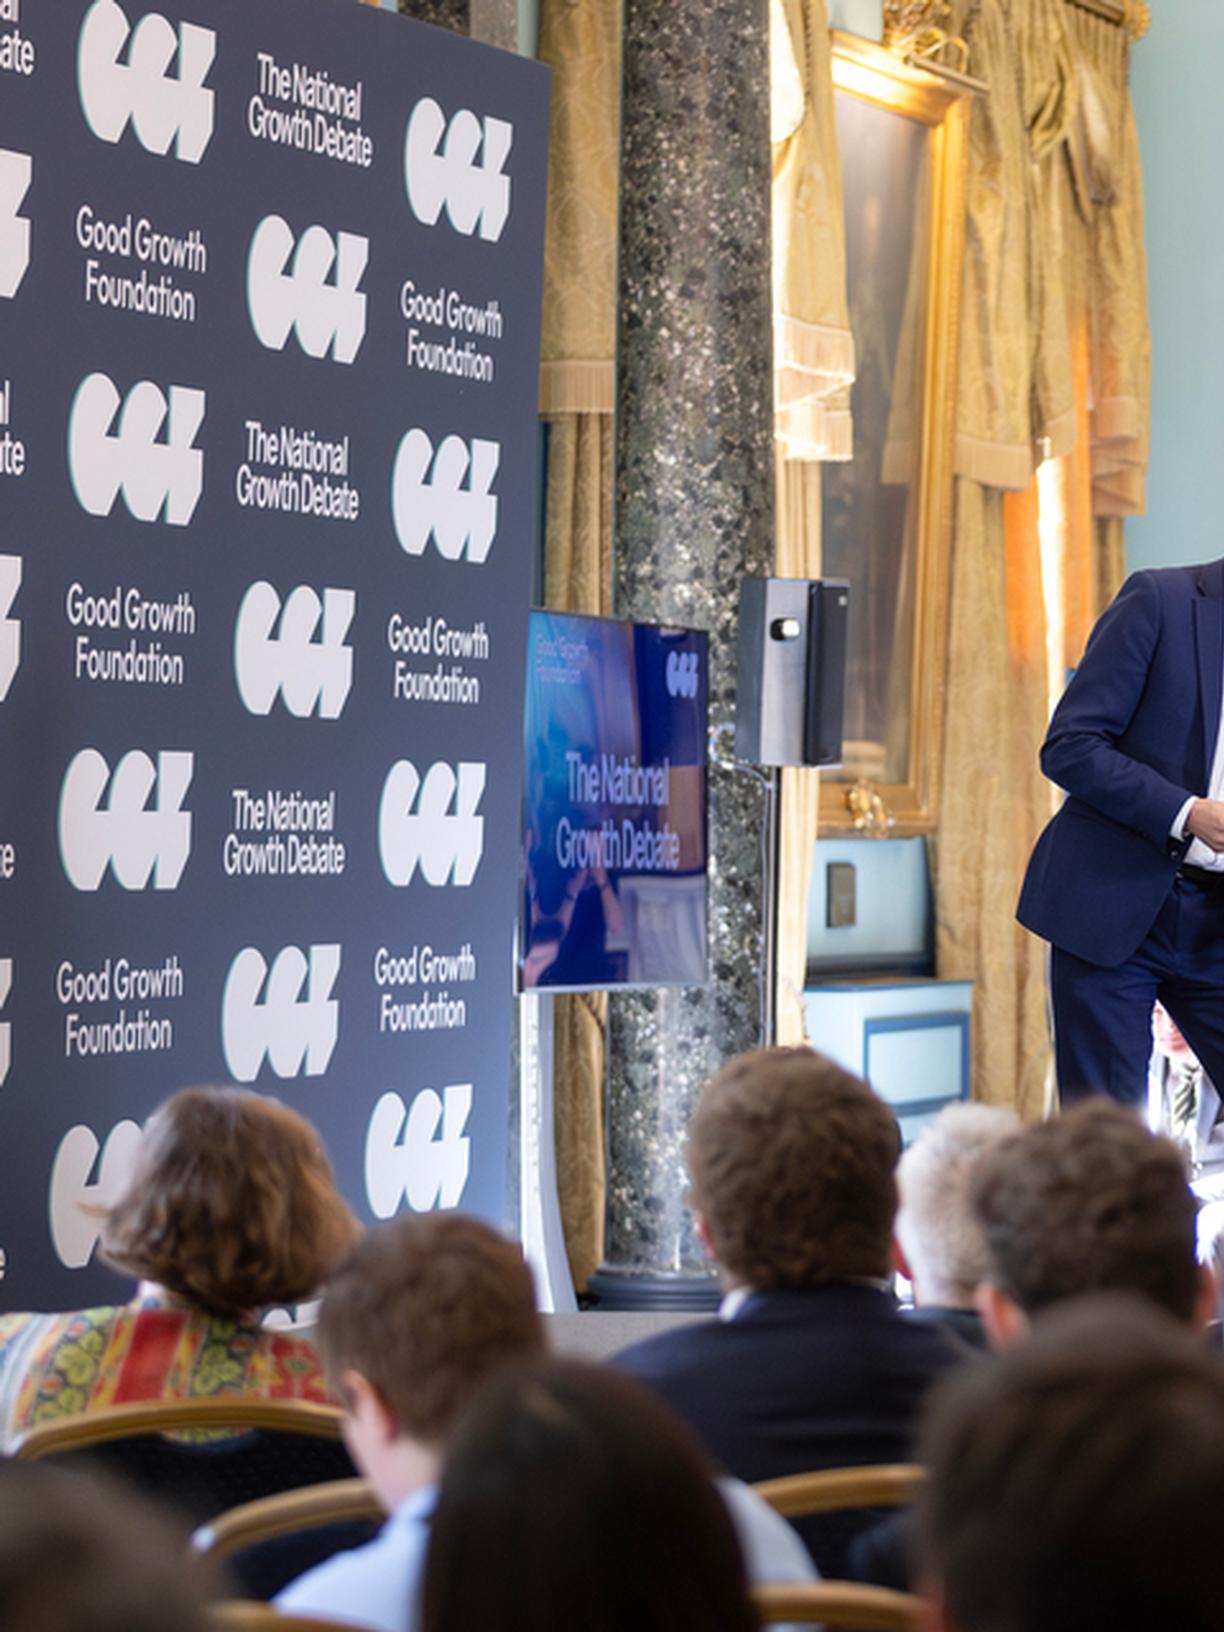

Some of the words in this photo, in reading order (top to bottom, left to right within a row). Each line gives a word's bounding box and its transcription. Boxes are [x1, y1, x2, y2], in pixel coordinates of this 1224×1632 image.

[257, 52, 292, 101] The
[292, 63, 362, 121] National
[248, 95, 313, 151] Growth
[313, 113, 373, 168] Debate
[76, 204, 132, 256] Good
[134, 218, 207, 273] Growth
[85, 259, 195, 322] Foundation
[400, 280, 445, 326] Good
[446, 290, 503, 339] Growth
[407, 328, 493, 382] Foundation
[244, 420, 279, 466] The
[279, 426, 349, 476] National
[236, 463, 300, 512] Growth
[300, 473, 359, 521] Debate
[66, 582, 122, 628] Good
[124, 587, 196, 634] Growth
[75, 635, 184, 684] Foundation
[387, 613, 432, 655] Good
[432, 617, 489, 660] Growth
[394, 660, 480, 704] Foundation
[565, 751, 600, 802] The
[601, 755, 671, 807] National
[232, 789, 266, 831] The
[266, 790, 335, 832] National
[223, 833, 286, 876] Growth
[286, 834, 346, 875] Debate
[555, 816, 622, 870] Growth
[621, 818, 681, 871] Debate
[56, 958, 111, 1004] Good
[113, 955, 183, 1001] Growth
[374, 945, 419, 987] Good
[418, 942, 476, 985] Growth
[66, 1009, 172, 1056] Foundation
[379, 990, 467, 1033] Foundation
